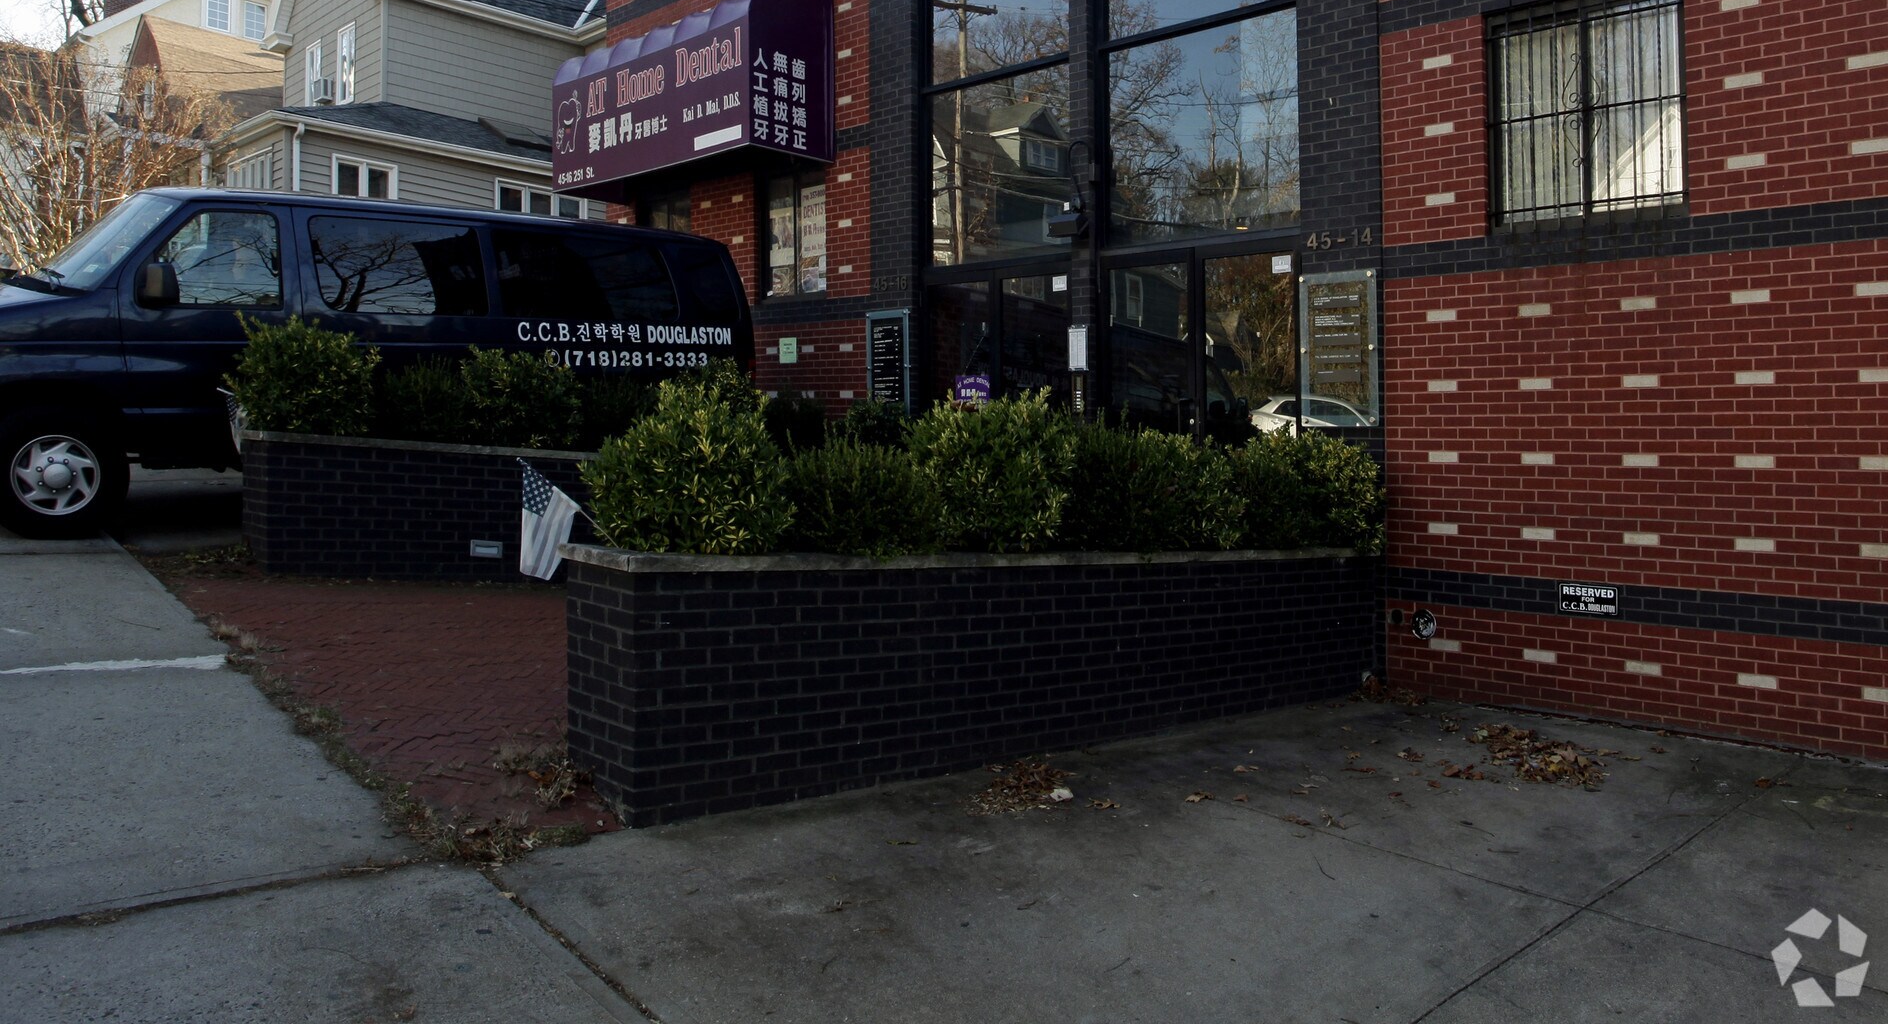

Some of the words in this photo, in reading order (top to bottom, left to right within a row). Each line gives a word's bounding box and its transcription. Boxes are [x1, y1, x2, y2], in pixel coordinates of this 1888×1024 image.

[586, 77, 607, 117] AT
[616, 64, 665, 108] Home
[675, 26, 742, 87] Dental
[753, 47, 769, 140] 人工植牙
[773, 51, 789, 146] 無痛拔牙
[682, 106, 694, 123] Kai
[706, 98, 721, 115] Mai,
[723, 91, 741, 110] D.D.S.
[573, 168, 584, 182] 251
[1307, 227, 1373, 250] 45-14
[873, 276, 907, 292] 45-16
[647, 325, 732, 345] DOUGLASTON
[564, 350, 708, 368] (718)281-3333
[1562, 586, 1614, 598] RESERVED
